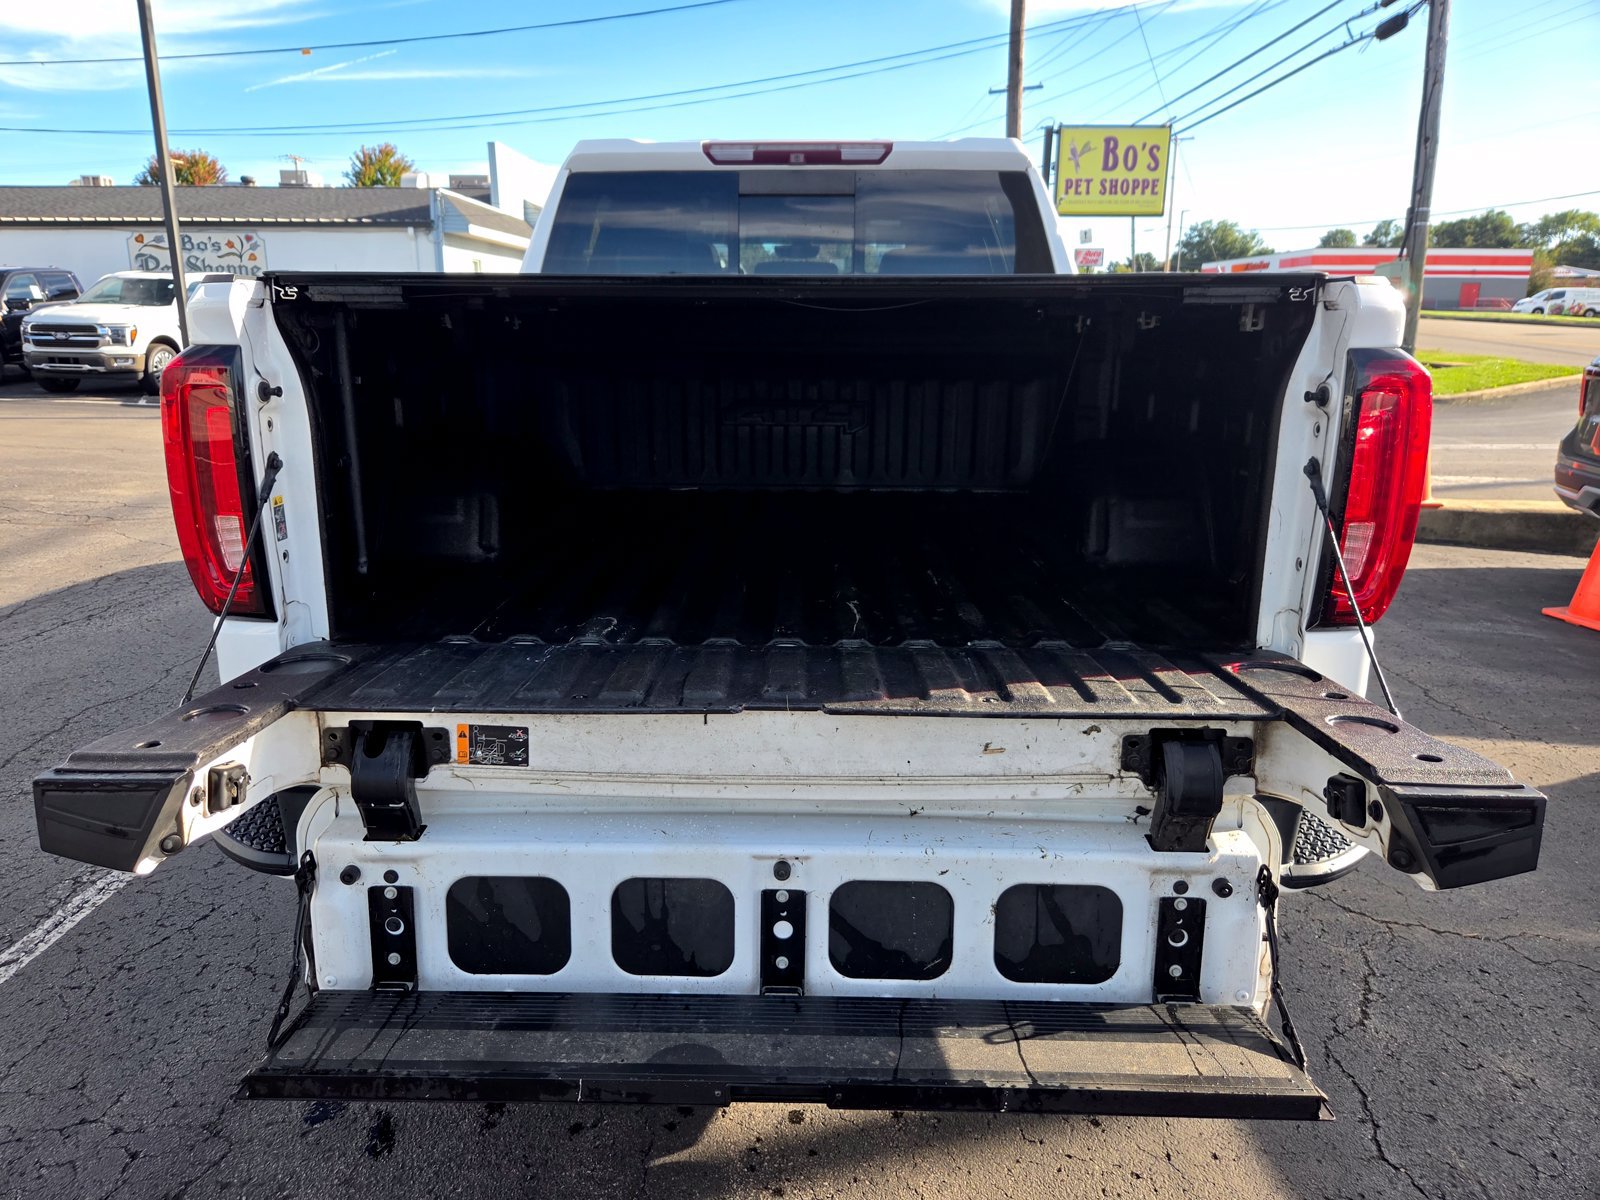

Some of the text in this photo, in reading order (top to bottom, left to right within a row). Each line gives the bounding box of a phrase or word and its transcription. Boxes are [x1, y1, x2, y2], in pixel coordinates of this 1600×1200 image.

[1064, 178, 1159, 195] PET SHOPPE
[180, 234, 222, 252] Bo's
